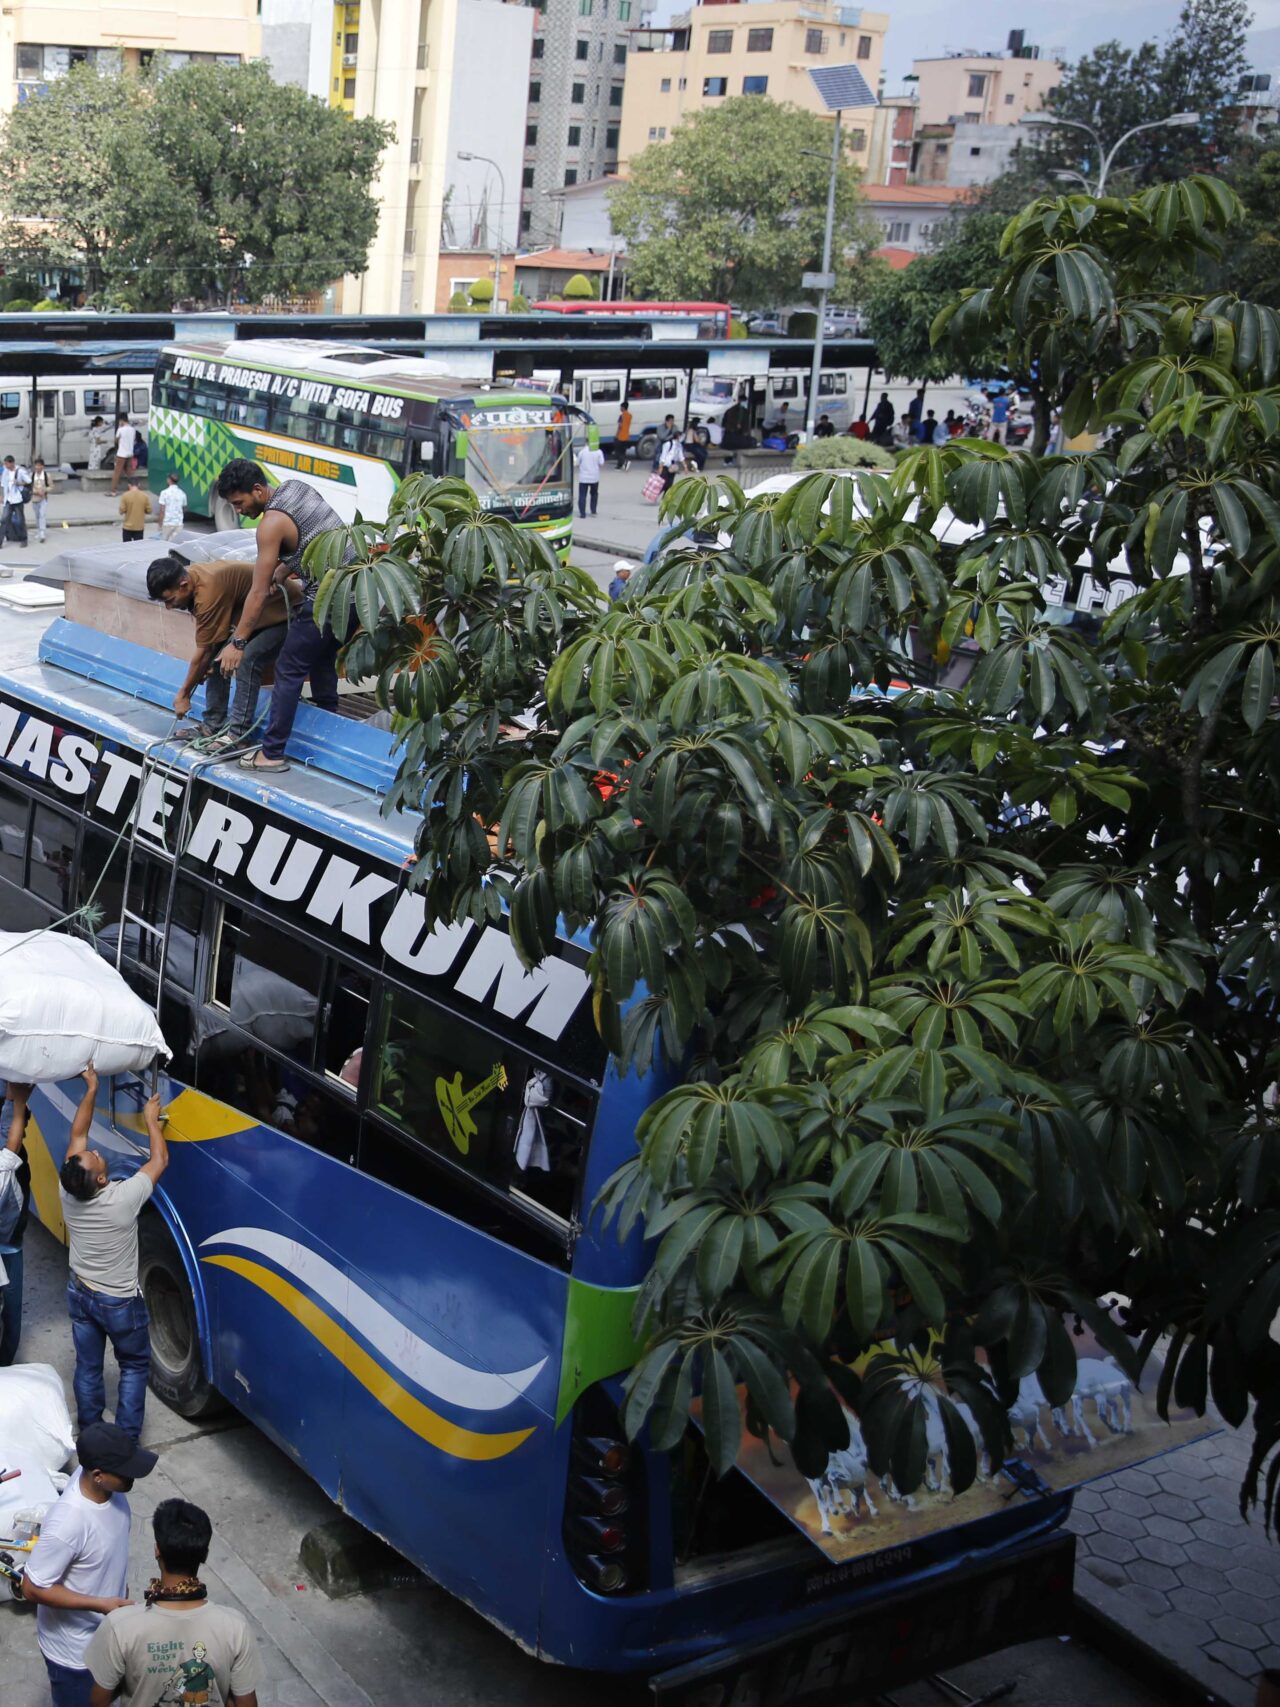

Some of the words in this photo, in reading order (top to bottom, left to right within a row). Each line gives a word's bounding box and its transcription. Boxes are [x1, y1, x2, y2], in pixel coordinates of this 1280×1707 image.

[173, 357, 205, 379] PRIYA
[206, 366, 216, 382] &
[217, 365, 270, 393] PRABESH
[271, 377, 298, 398] A/C
[299, 382, 332, 405] WITH
[332, 387, 370, 414] SOFA
[371, 391, 404, 420] BUS
[186, 798, 592, 1042] RUKUM
[146, 1640, 185, 1654] Eight
[152, 1652, 176, 1662] Days
[147, 1665, 176, 1674] Week
